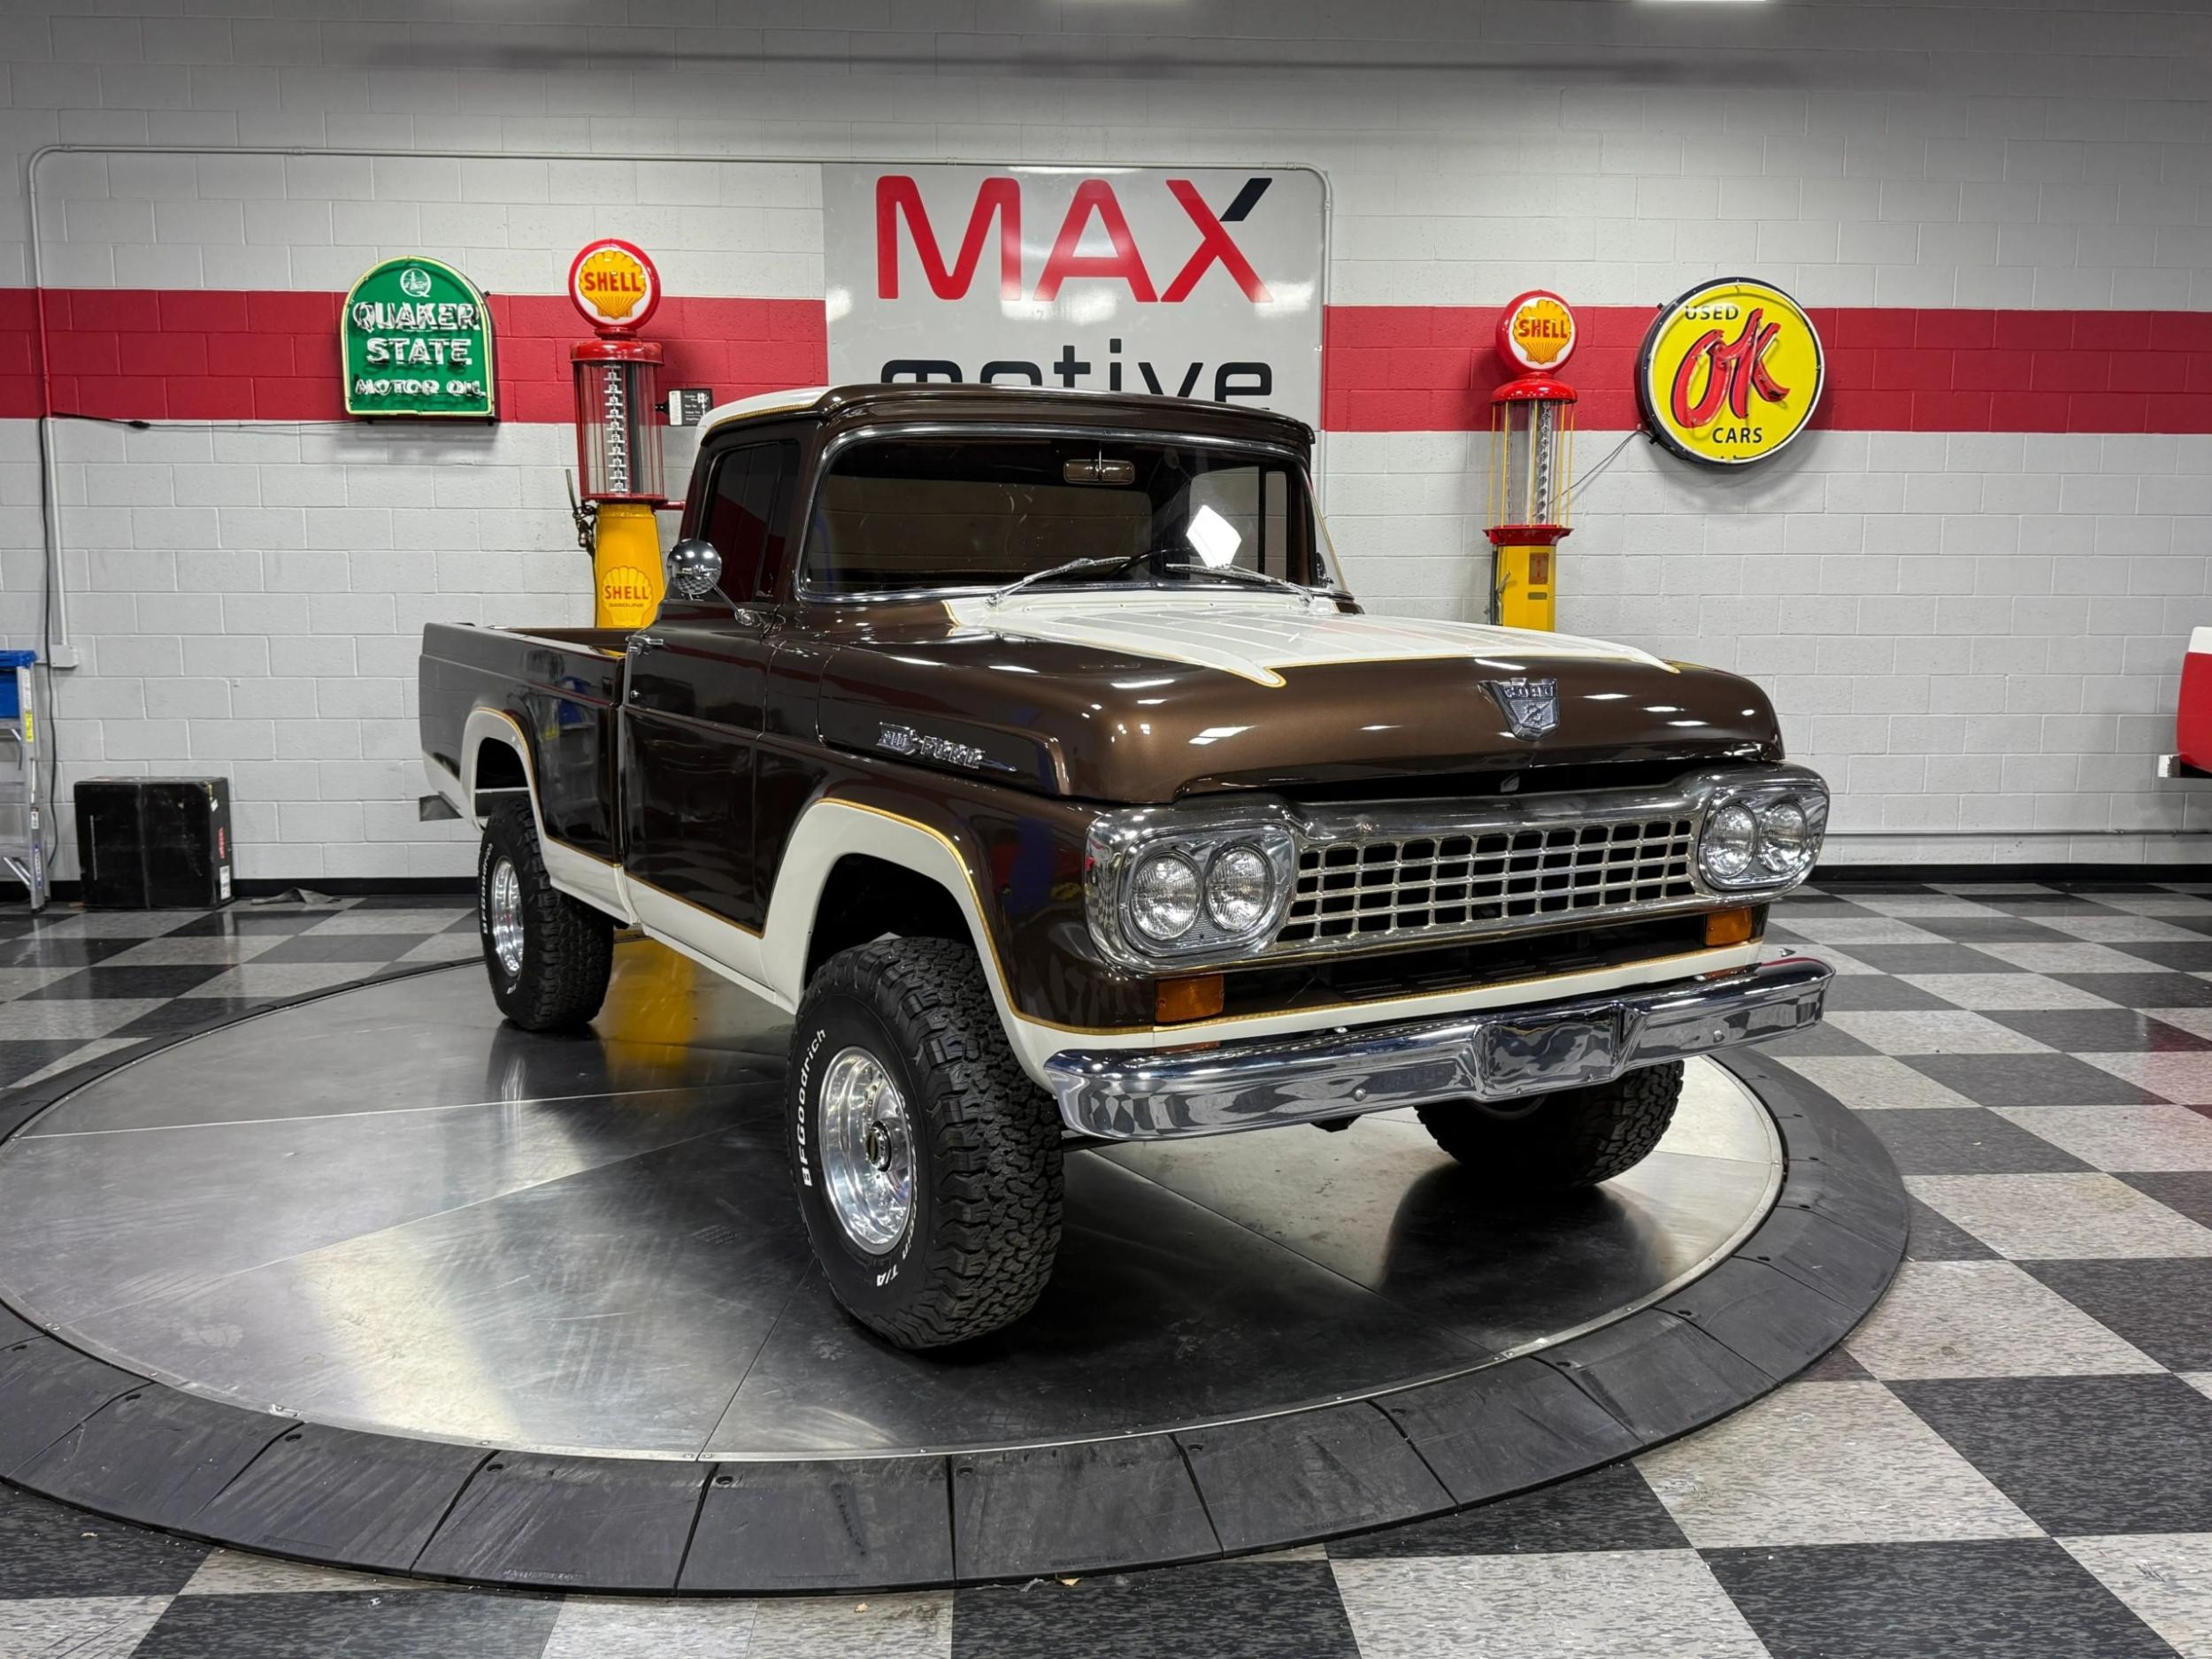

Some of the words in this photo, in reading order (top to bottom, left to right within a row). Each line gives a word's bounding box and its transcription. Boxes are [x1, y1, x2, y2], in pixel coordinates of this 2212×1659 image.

[876, 175, 1273, 303] MAX
[584, 272, 642, 292] SHELL
[352, 302, 481, 333] QUAKER
[1685, 305, 1739, 320] USED
[1517, 319, 1568, 339] SHELL
[366, 337, 472, 365] STATE
[1671, 308, 1791, 428] OK
[355, 379, 440, 396] MOTOR
[446, 380, 486, 397] OIL
[1712, 427, 1763, 443] CARS
[604, 585, 649, 600] SHELL
[1504, 685, 1554, 698] FORD
[796, 1028, 826, 1187] BFGoodrich
[876, 1263, 899, 1287] T/A
